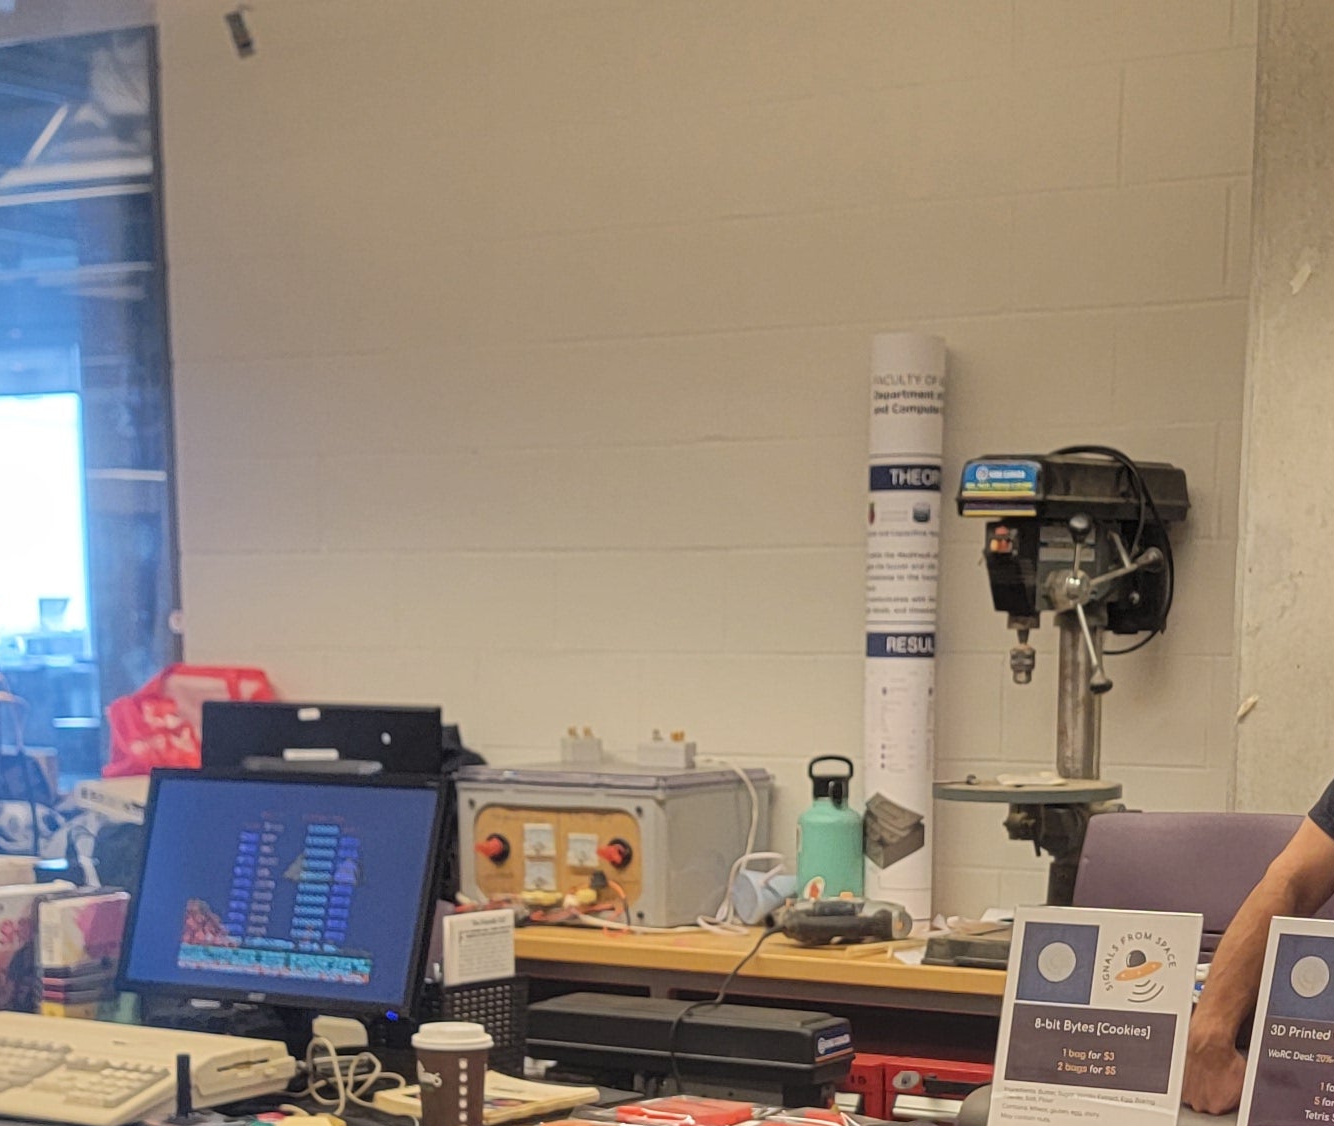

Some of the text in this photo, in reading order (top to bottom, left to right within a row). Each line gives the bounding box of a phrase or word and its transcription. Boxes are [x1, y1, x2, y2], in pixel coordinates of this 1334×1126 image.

[1102, 931, 1177, 992] SIGNALS FROM SPACE
[1034, 1017, 1151, 1040] 8-bit Bytes [Cookies]
[1270, 1024, 1287, 1036] 3D
[1289, 1027, 1331, 1041] Printed
[1062, 1048, 1115, 1061] 1 bag for $3
[1293, 1051, 1314, 1062] Deal:
[1057, 1062, 1117, 1075] 2 bags for $5
[1320, 1082, 1325, 1091] 1
[1314, 1096, 1320, 1105] 5
[1304, 1109, 1330, 1122] Tetris
